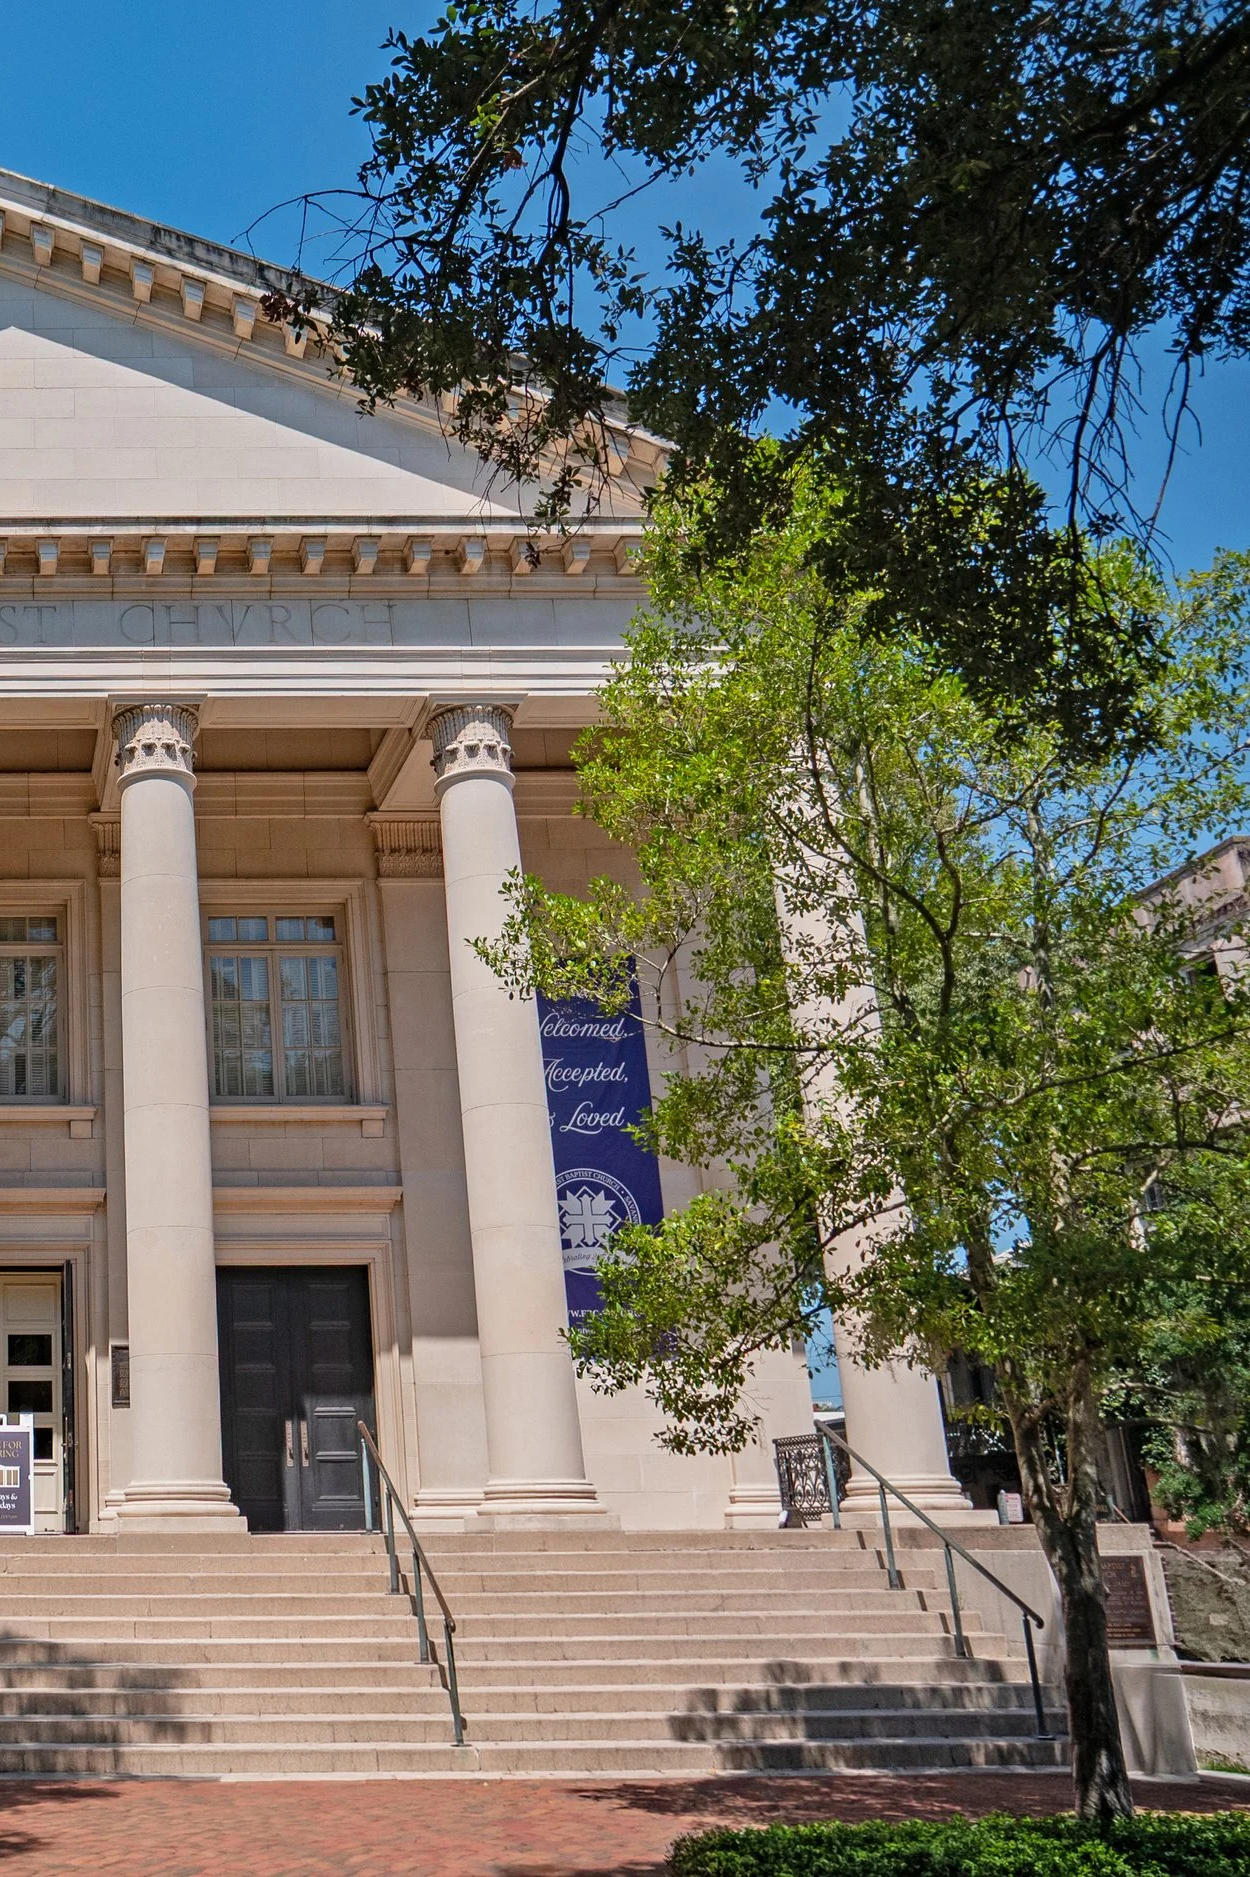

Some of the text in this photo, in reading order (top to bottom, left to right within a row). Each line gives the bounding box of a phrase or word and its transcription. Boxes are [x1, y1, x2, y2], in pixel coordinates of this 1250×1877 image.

[118, 603, 397, 643] CHVRCH
[559, 1101, 625, 1134] Loved
[565, 1171, 593, 1181] BAPTIST
[593, 1173, 620, 1191] CHURCH
[3, 1441, 22, 1449] FOR
[10, 1493, 18, 1501] &
